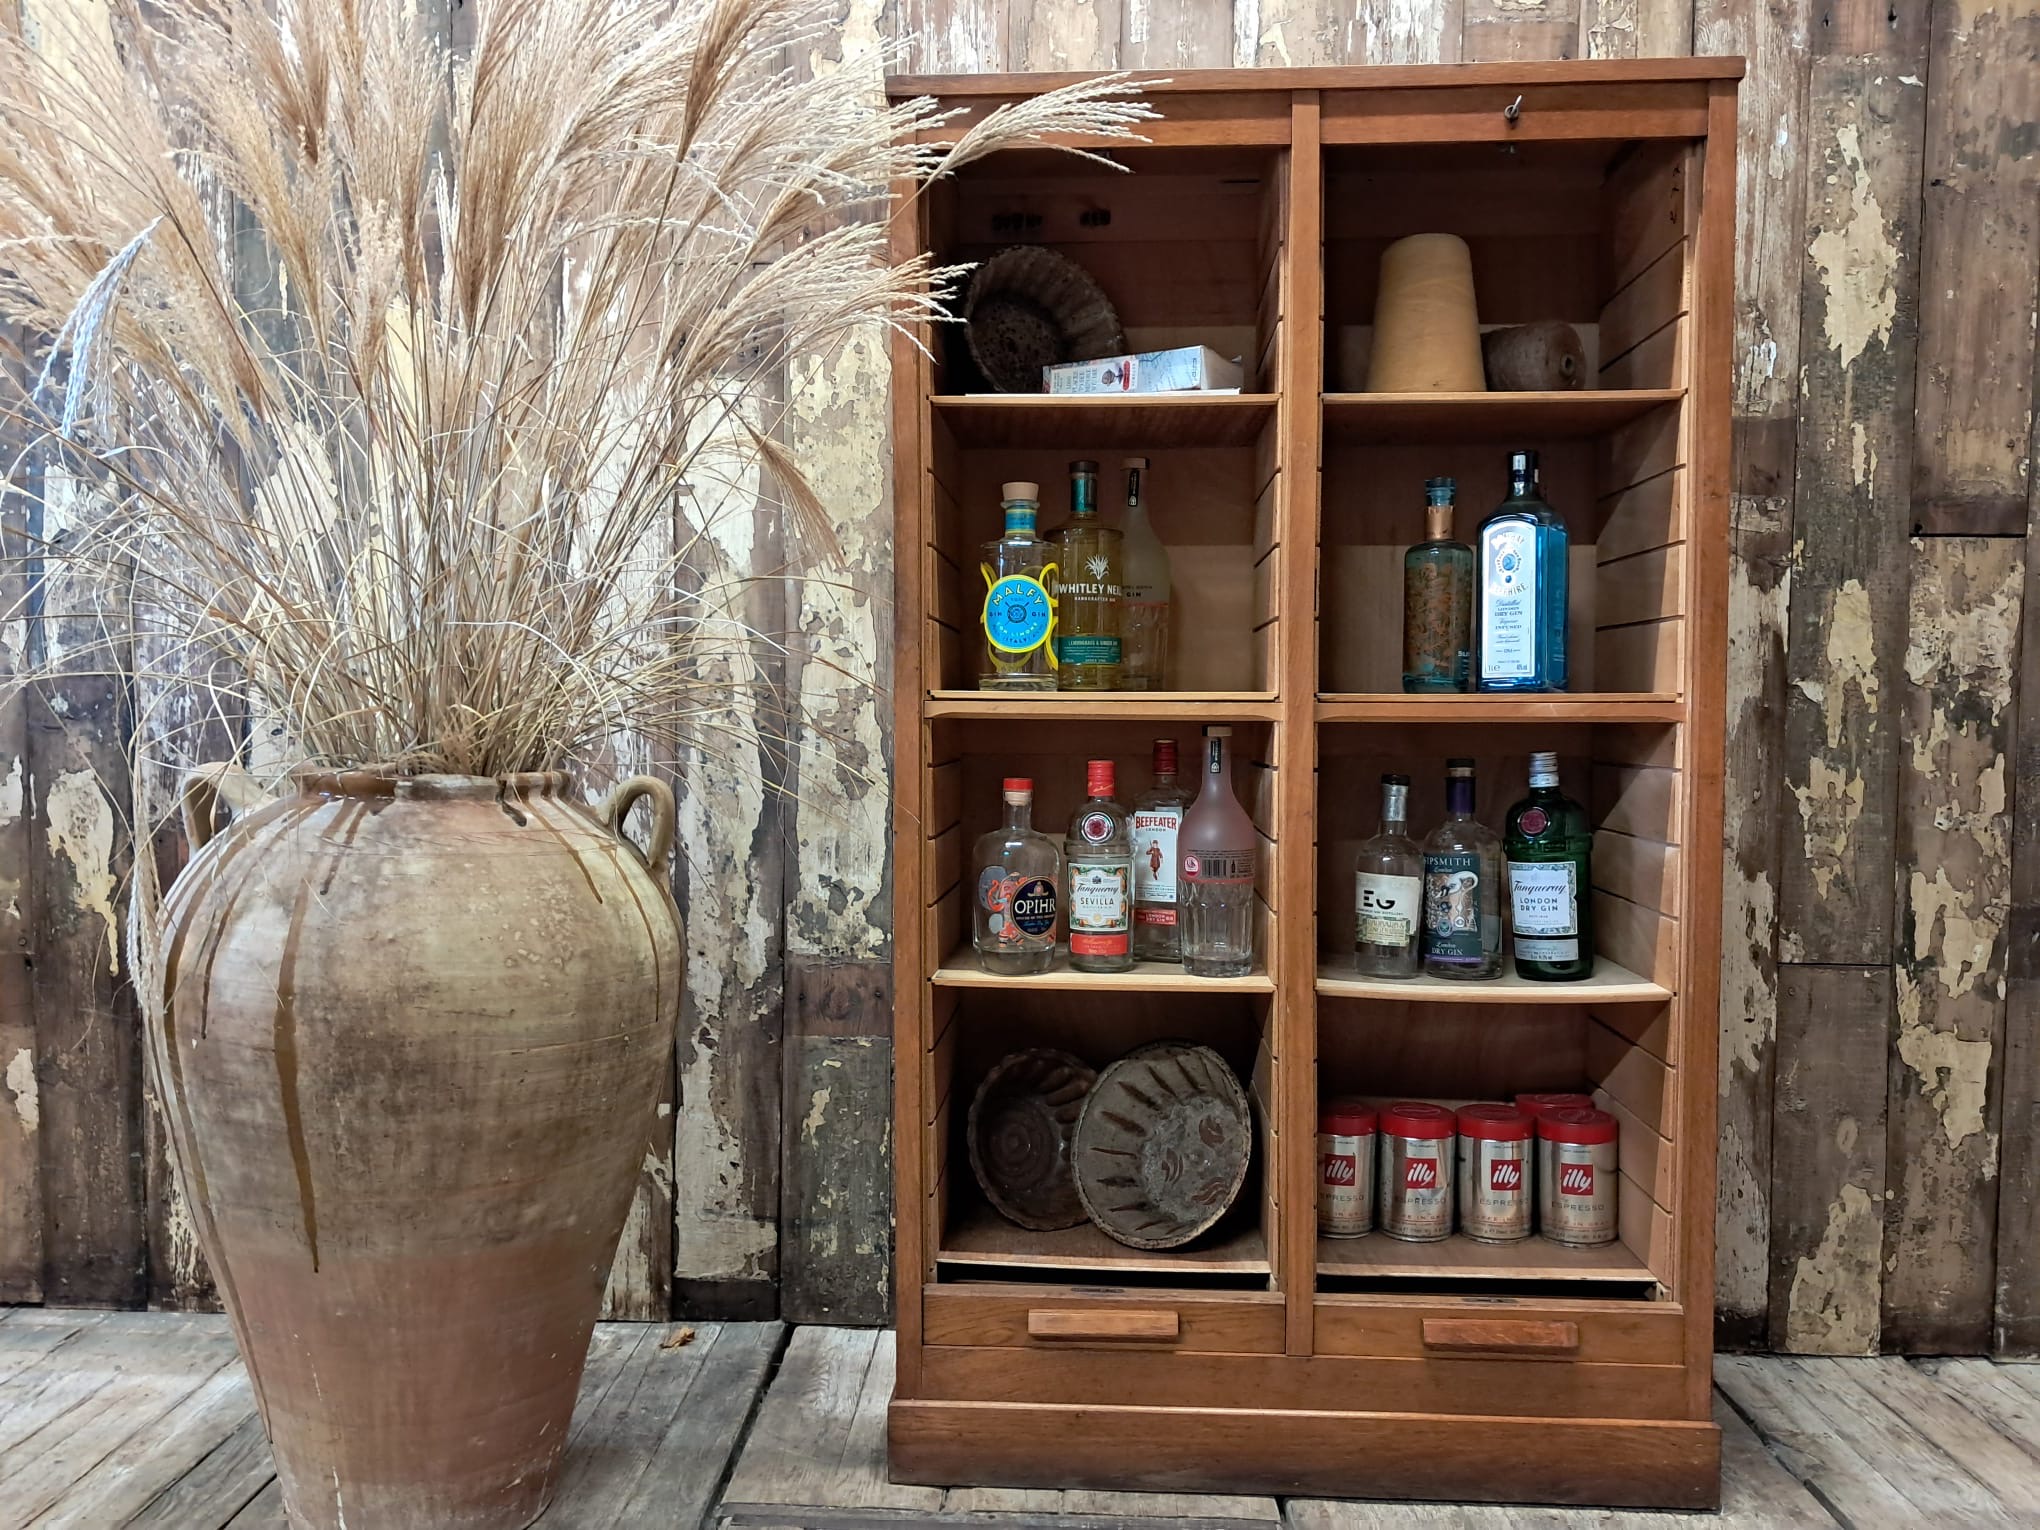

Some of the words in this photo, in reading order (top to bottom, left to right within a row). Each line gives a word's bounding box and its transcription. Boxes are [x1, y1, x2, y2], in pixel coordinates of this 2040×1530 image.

[992, 583, 1044, 607] MALFY
[1058, 583, 1105, 594] WHITLEY
[1135, 816, 1177, 830] BEEFEATER
[1076, 882, 1119, 895] Tanqueray
[1514, 880, 1567, 895] Tanqueray
[1014, 898, 1056, 914] OPIHR
[1080, 897, 1114, 906] SEVILLA
[1520, 904, 1537, 912] DRY
[1326, 1160, 1354, 1184] illy
[1407, 1163, 1435, 1186] illy
[1493, 1164, 1520, 1188] illy
[1562, 1168, 1592, 1192] illy
